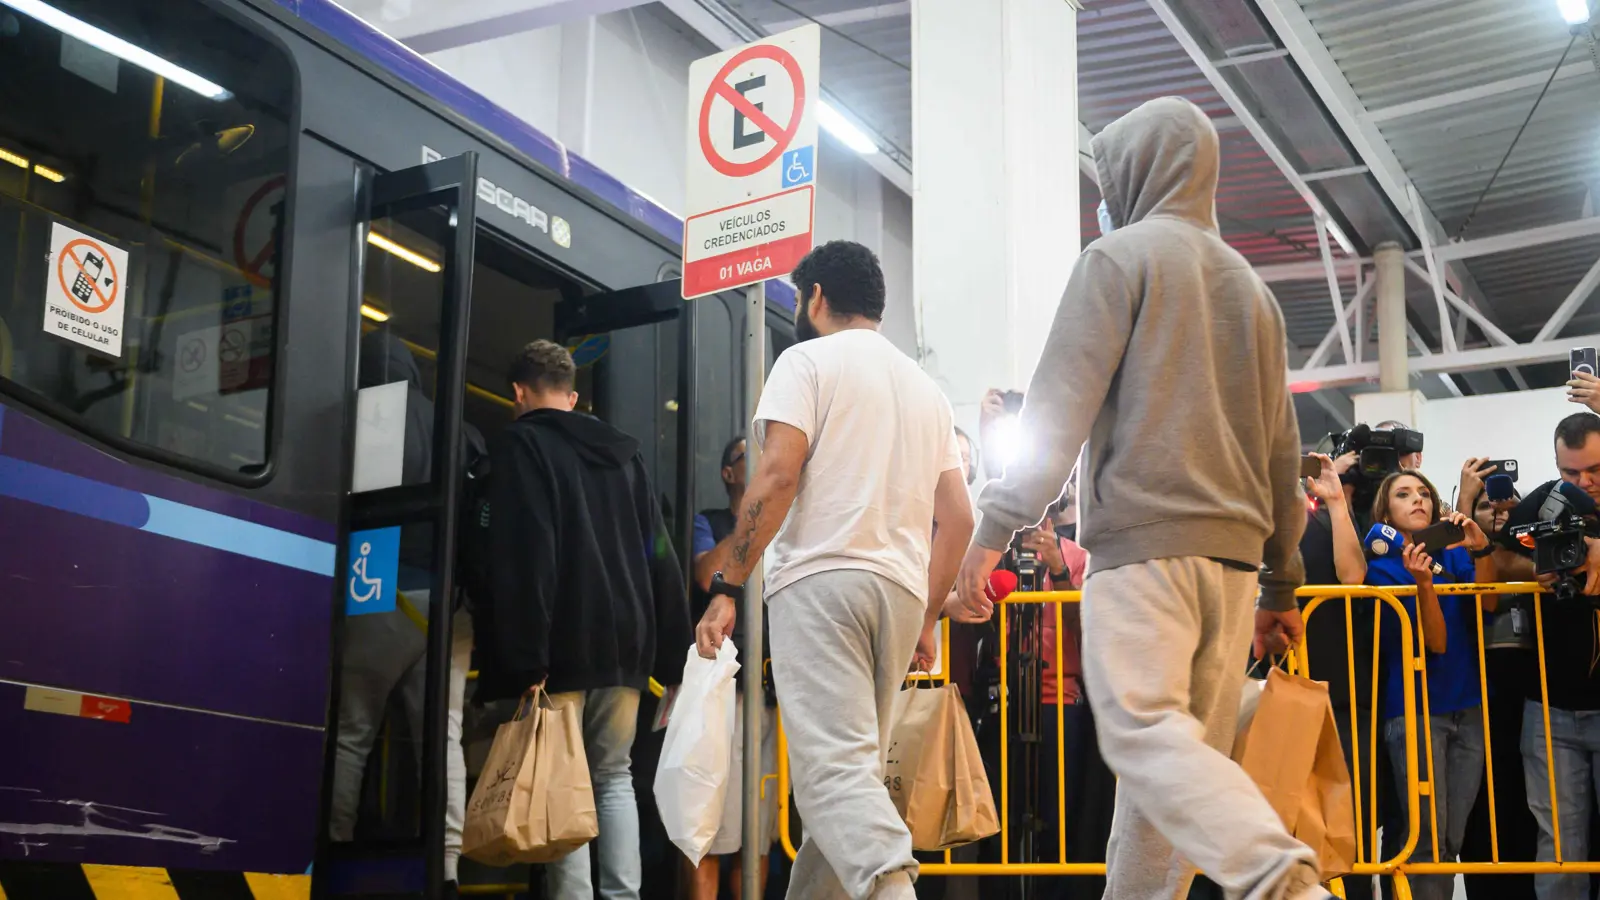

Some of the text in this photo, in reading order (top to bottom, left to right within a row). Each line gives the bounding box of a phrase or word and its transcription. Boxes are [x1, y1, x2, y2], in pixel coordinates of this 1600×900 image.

[733, 75, 766, 150] E
[719, 210, 771, 231] VEÍCULOS
[704, 221, 786, 250] CREDENCIADOS
[719, 256, 772, 280] 01 VAGA
[49, 305, 119, 337] PROIBIDO O USO
[57, 321, 109, 345] DE CELULAR
